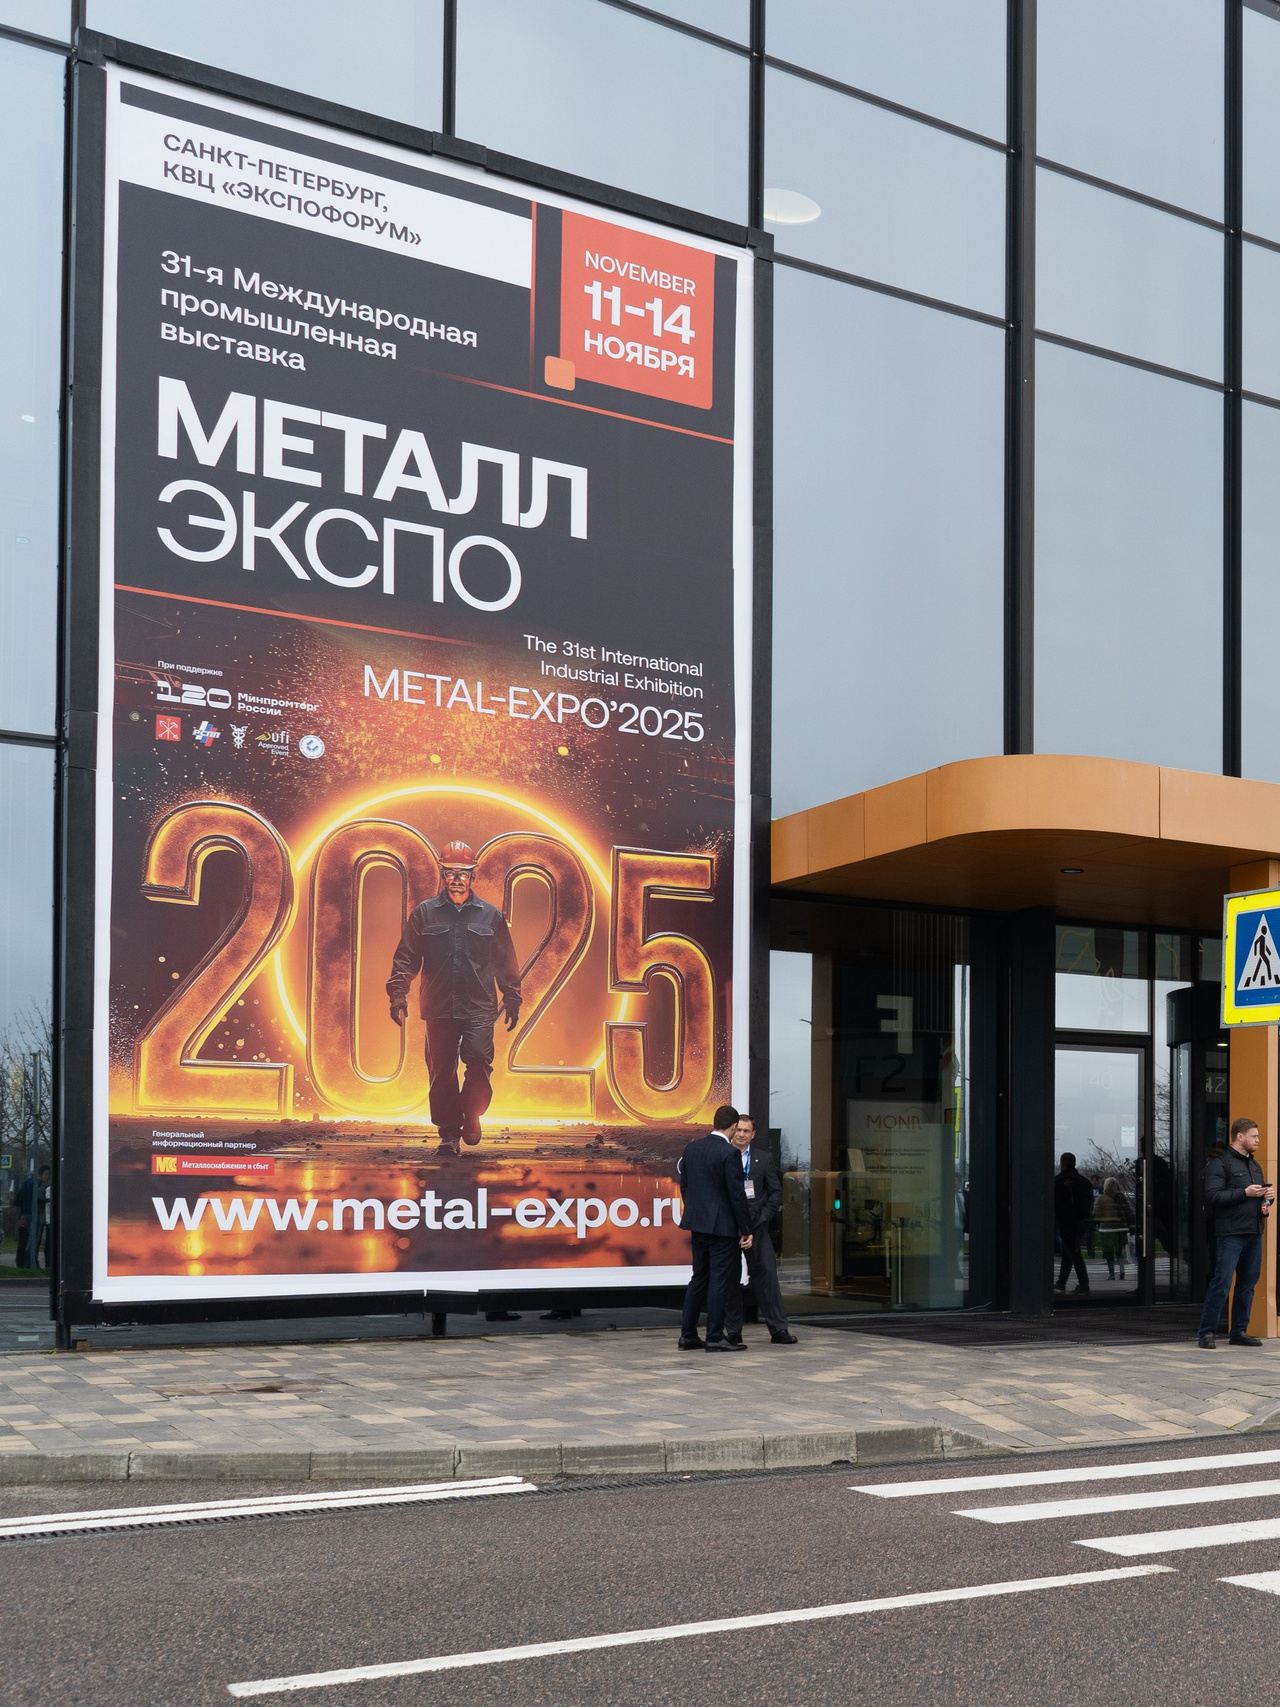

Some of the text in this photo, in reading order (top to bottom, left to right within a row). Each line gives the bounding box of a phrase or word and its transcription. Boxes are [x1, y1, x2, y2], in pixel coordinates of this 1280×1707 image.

[163, 133, 389, 214] САНКТ-ПЕТЕРБУРГ,
[163, 160, 422, 247] КВЦ «ЭКСПОФОРУМ»
[584, 250, 697, 297] NOVEMBER
[160, 250, 478, 348] 31-я Международная
[160, 287, 398, 360] промышленная
[160, 321, 306, 371] выставка
[583, 331, 696, 379] НОЯБРЯ
[157, 375, 589, 540] МЕТАЛЛ
[156, 478, 522, 612] ЭКСПО
[158, 660, 224, 677] При поддержке
[523, 634, 703, 677] The 31st International
[541, 660, 704, 699] Industrial Exhibition
[237, 692, 320, 712] Минпромторг
[237, 702, 282, 716] России
[258, 742, 289, 750] Approved
[271, 748, 289, 756] Event
[272, 730, 289, 744] ufi
[133, 800, 716, 1124] 2025
[152, 1130, 204, 1138] Генеральный
[152, 1140, 256, 1150] информационный партнер
[182, 1161, 246, 1170] Металлоснабжение
